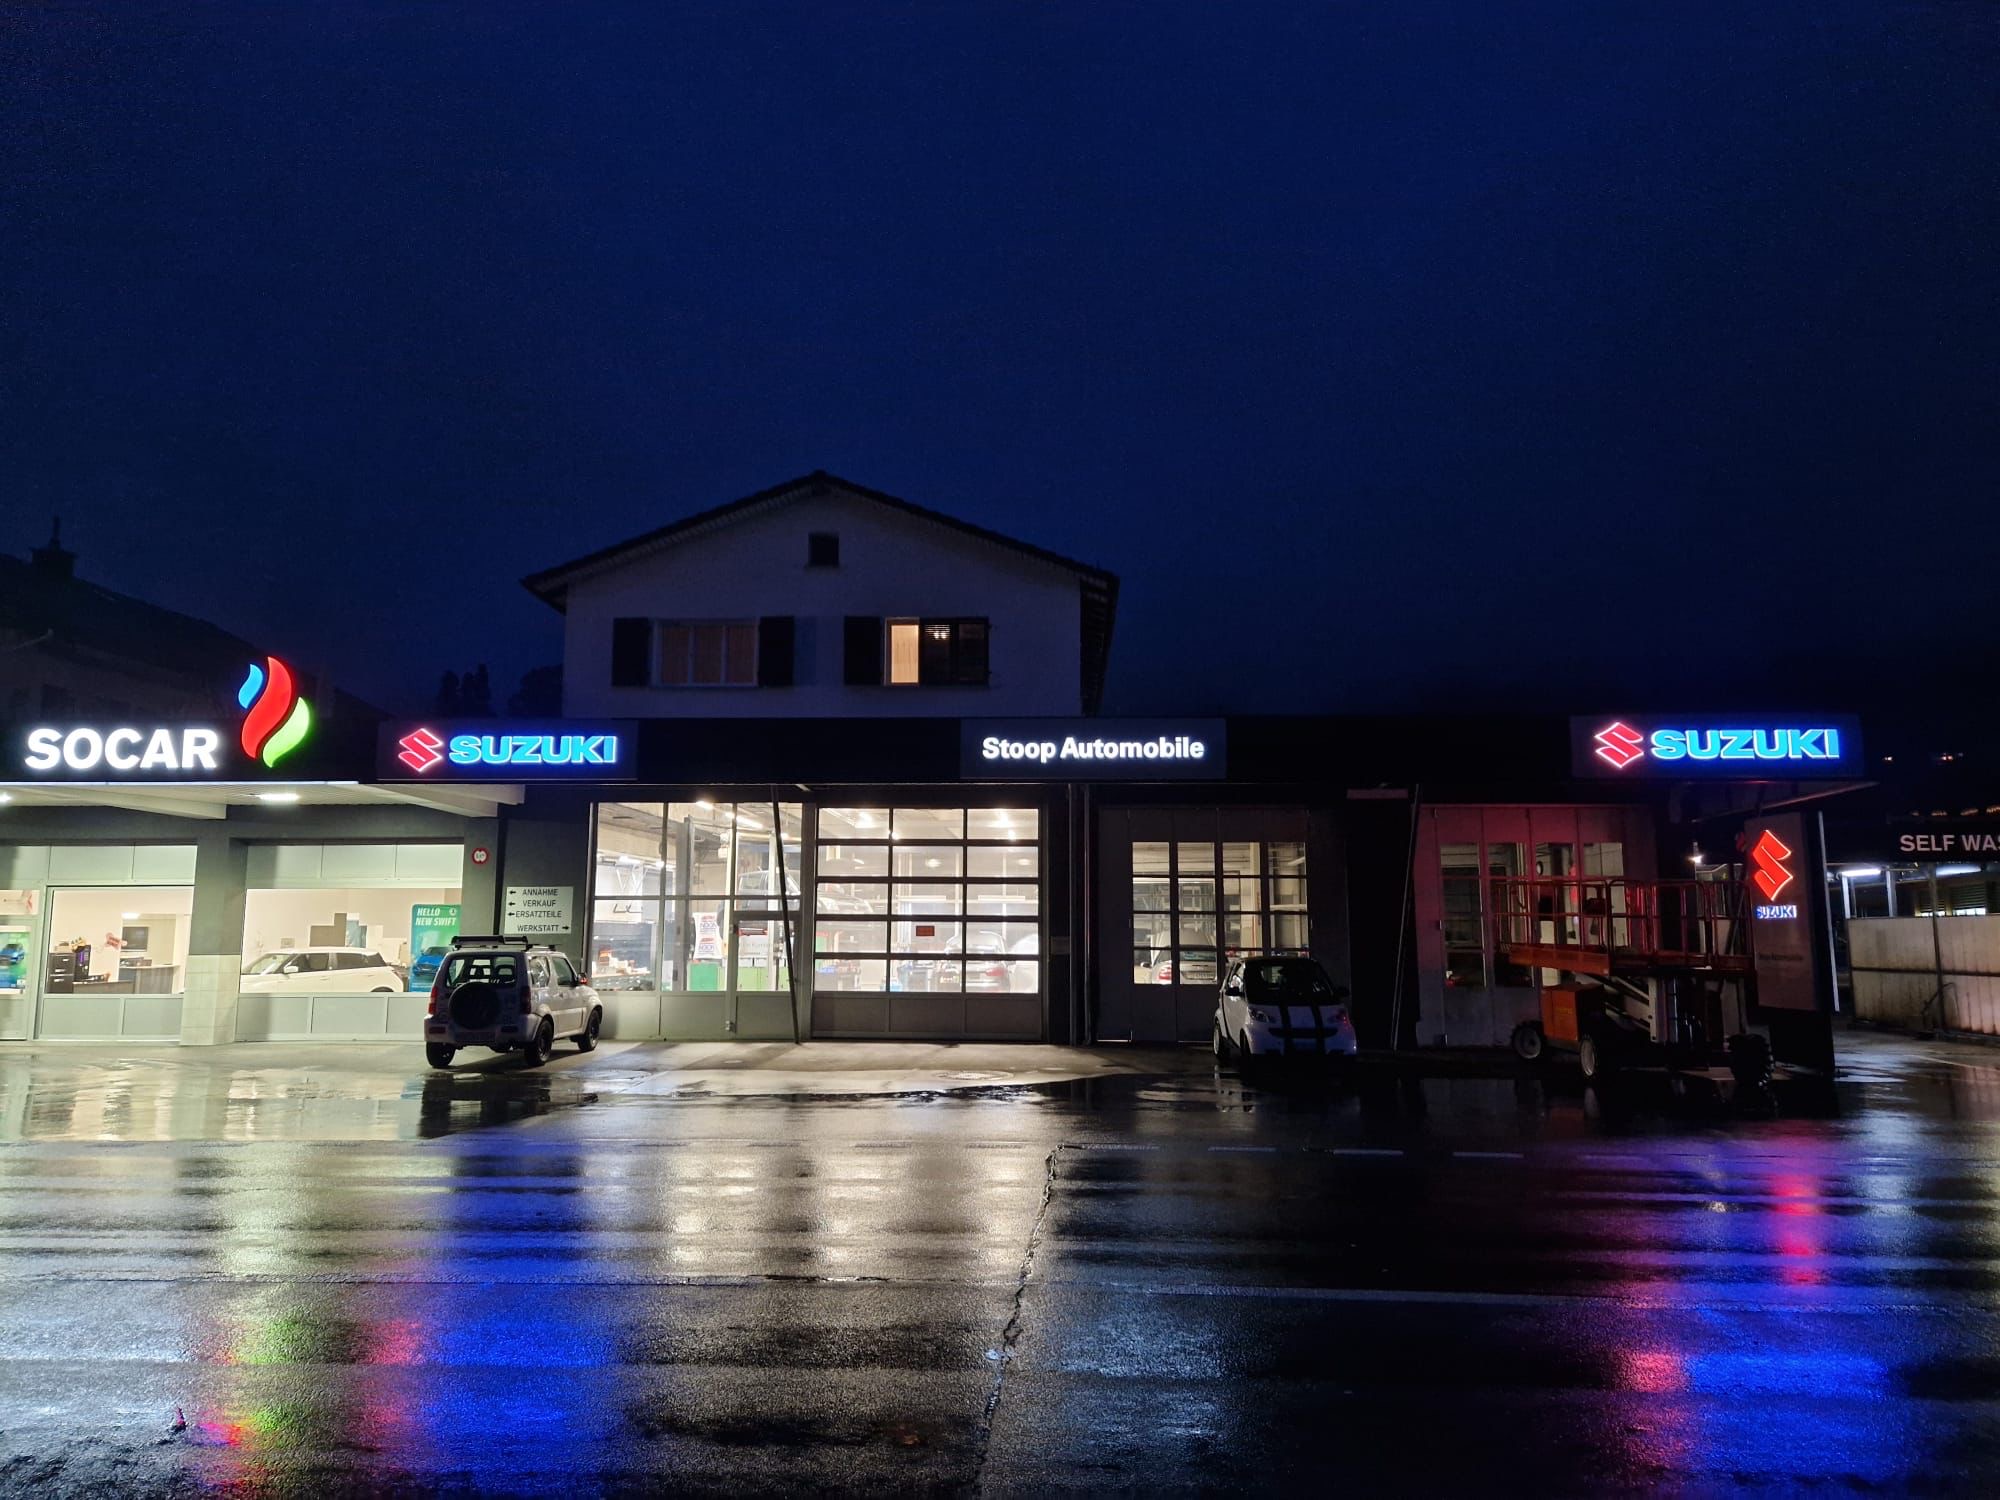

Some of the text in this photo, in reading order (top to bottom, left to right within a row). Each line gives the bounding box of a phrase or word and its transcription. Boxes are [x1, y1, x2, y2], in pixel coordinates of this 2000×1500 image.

[24, 727, 219, 770] SOCAR
[449, 735, 618, 764] SUZUKI
[982, 736, 1205, 763] Stoop Automobile
[1651, 729, 1840, 760] SUZUKI
[1900, 834, 2000, 851] SELF WA
[522, 888, 559, 896] ANNAHME
[523, 899, 557, 908] VERKAUF
[417, 907, 441, 917] HELLO
[515, 910, 563, 918] ERSATZTEILE
[1756, 905, 1798, 919] SUZUKI
[415, 917, 457, 926] NEW SWIFT
[517, 924, 560, 932] WERKSTATT
